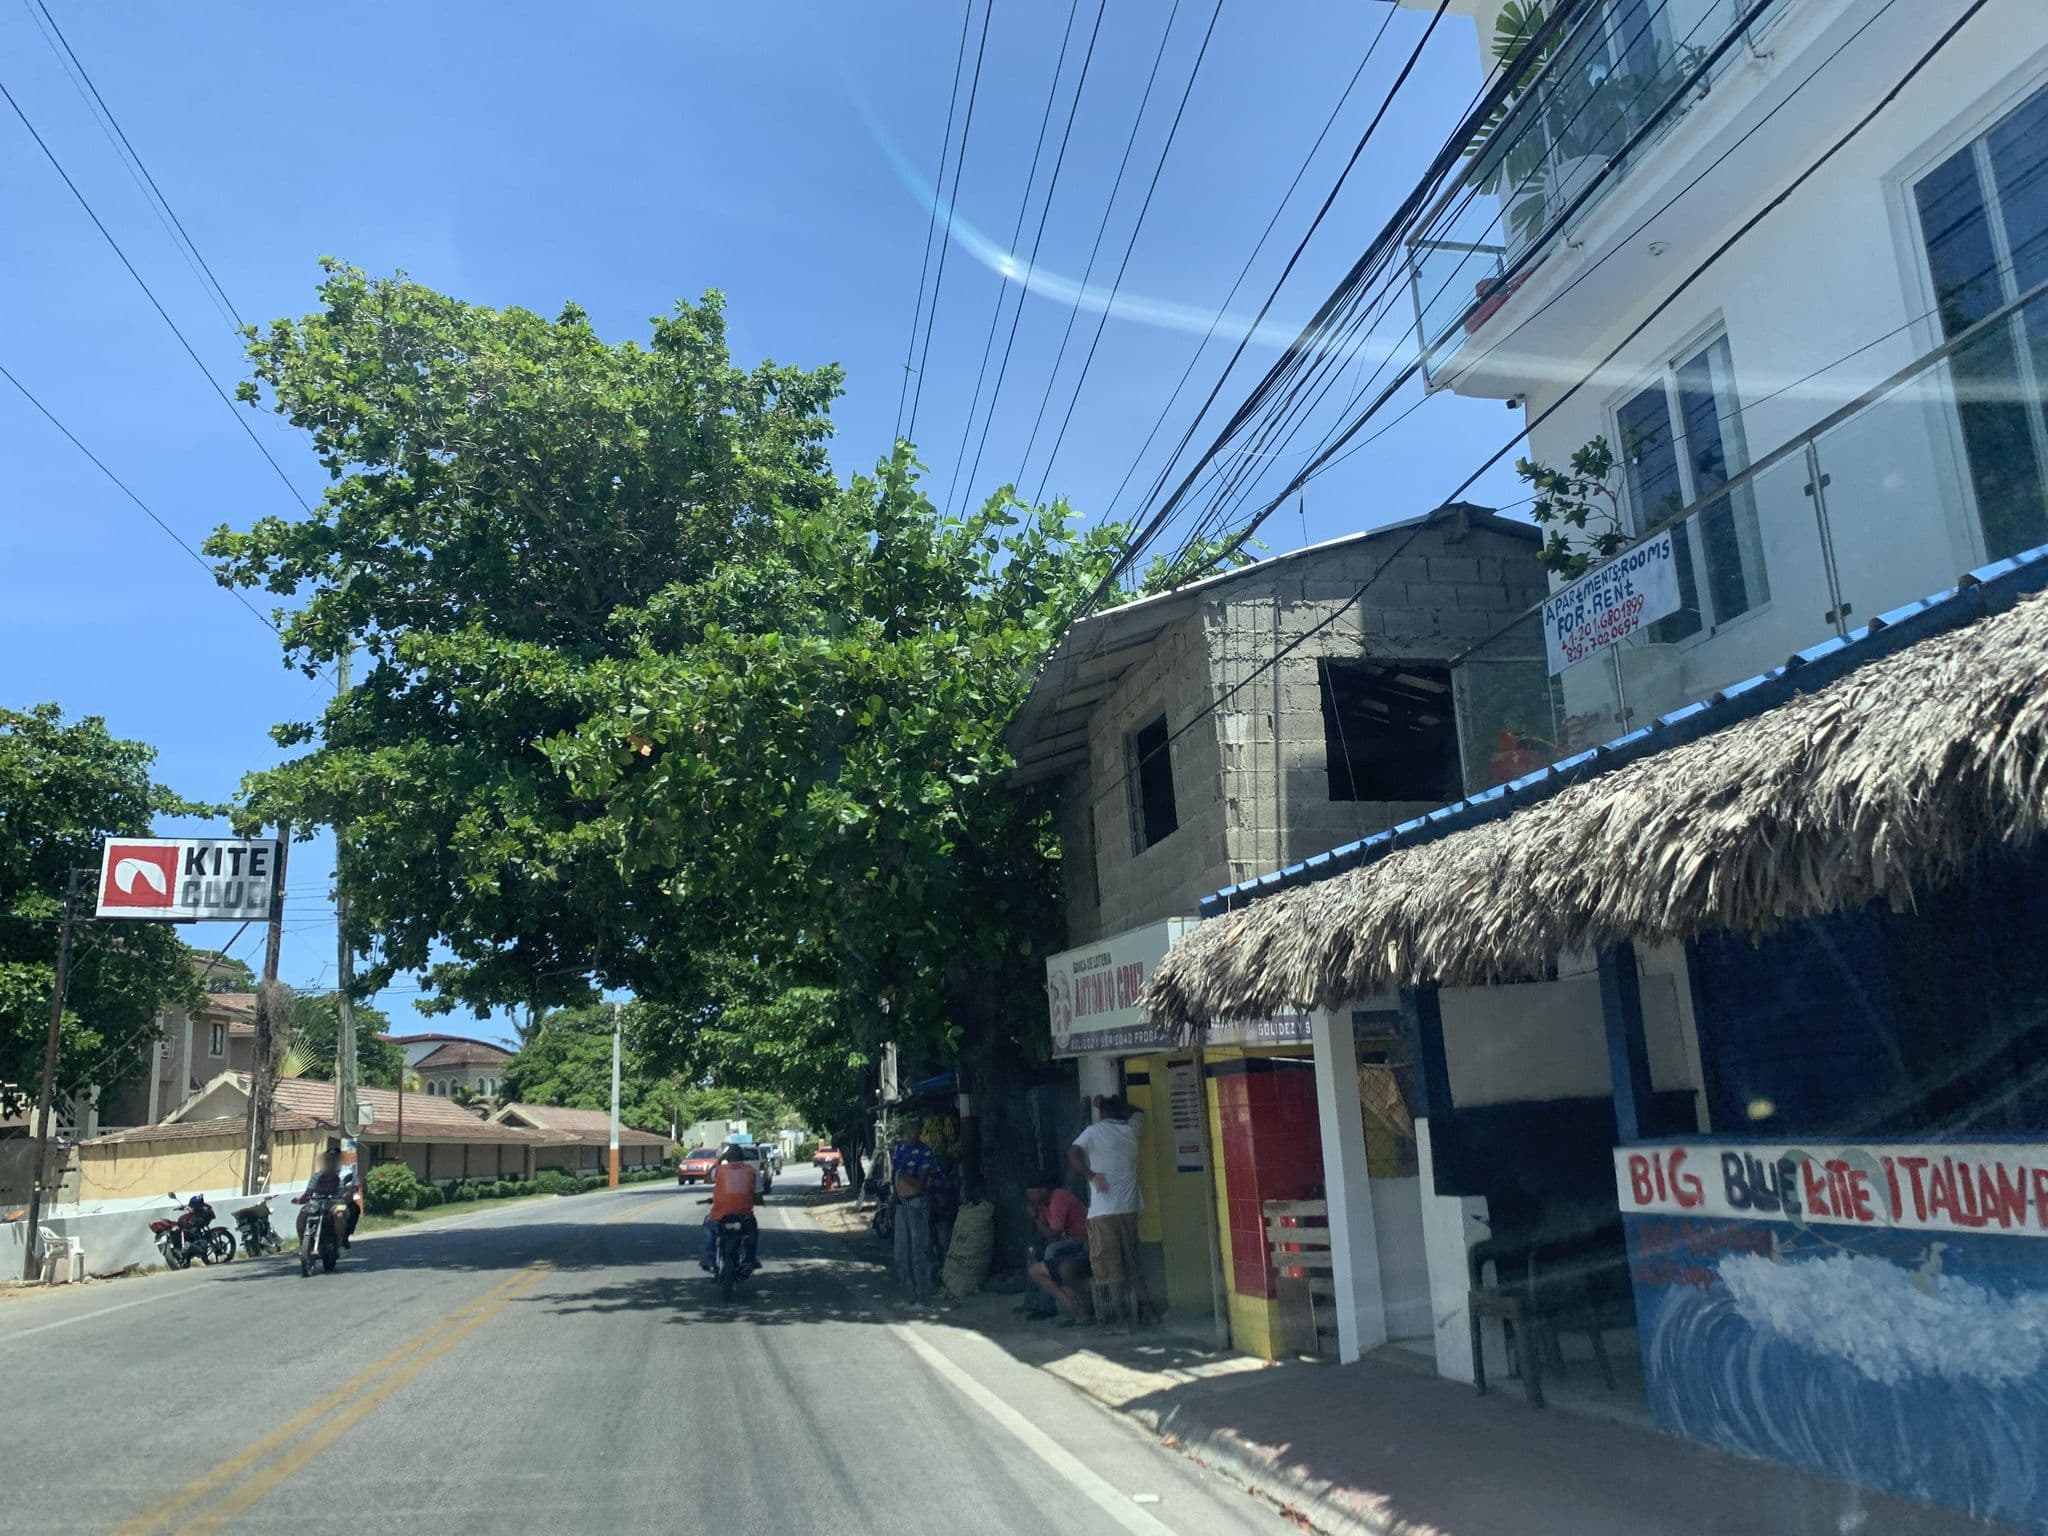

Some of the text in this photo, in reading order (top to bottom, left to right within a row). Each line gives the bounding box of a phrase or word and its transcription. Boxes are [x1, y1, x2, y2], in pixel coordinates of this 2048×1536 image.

[184, 846, 269, 877] KITE
[181, 880, 267, 909] CLUB
[1259, 1021, 1295, 1036] SOLIDEZ
[1628, 1147, 1705, 1208] BIG
[1720, 1151, 1803, 1212] BLUE
[1802, 1158, 1874, 1222] KITE
[1882, 1155, 2027, 1228] ITALIAN
